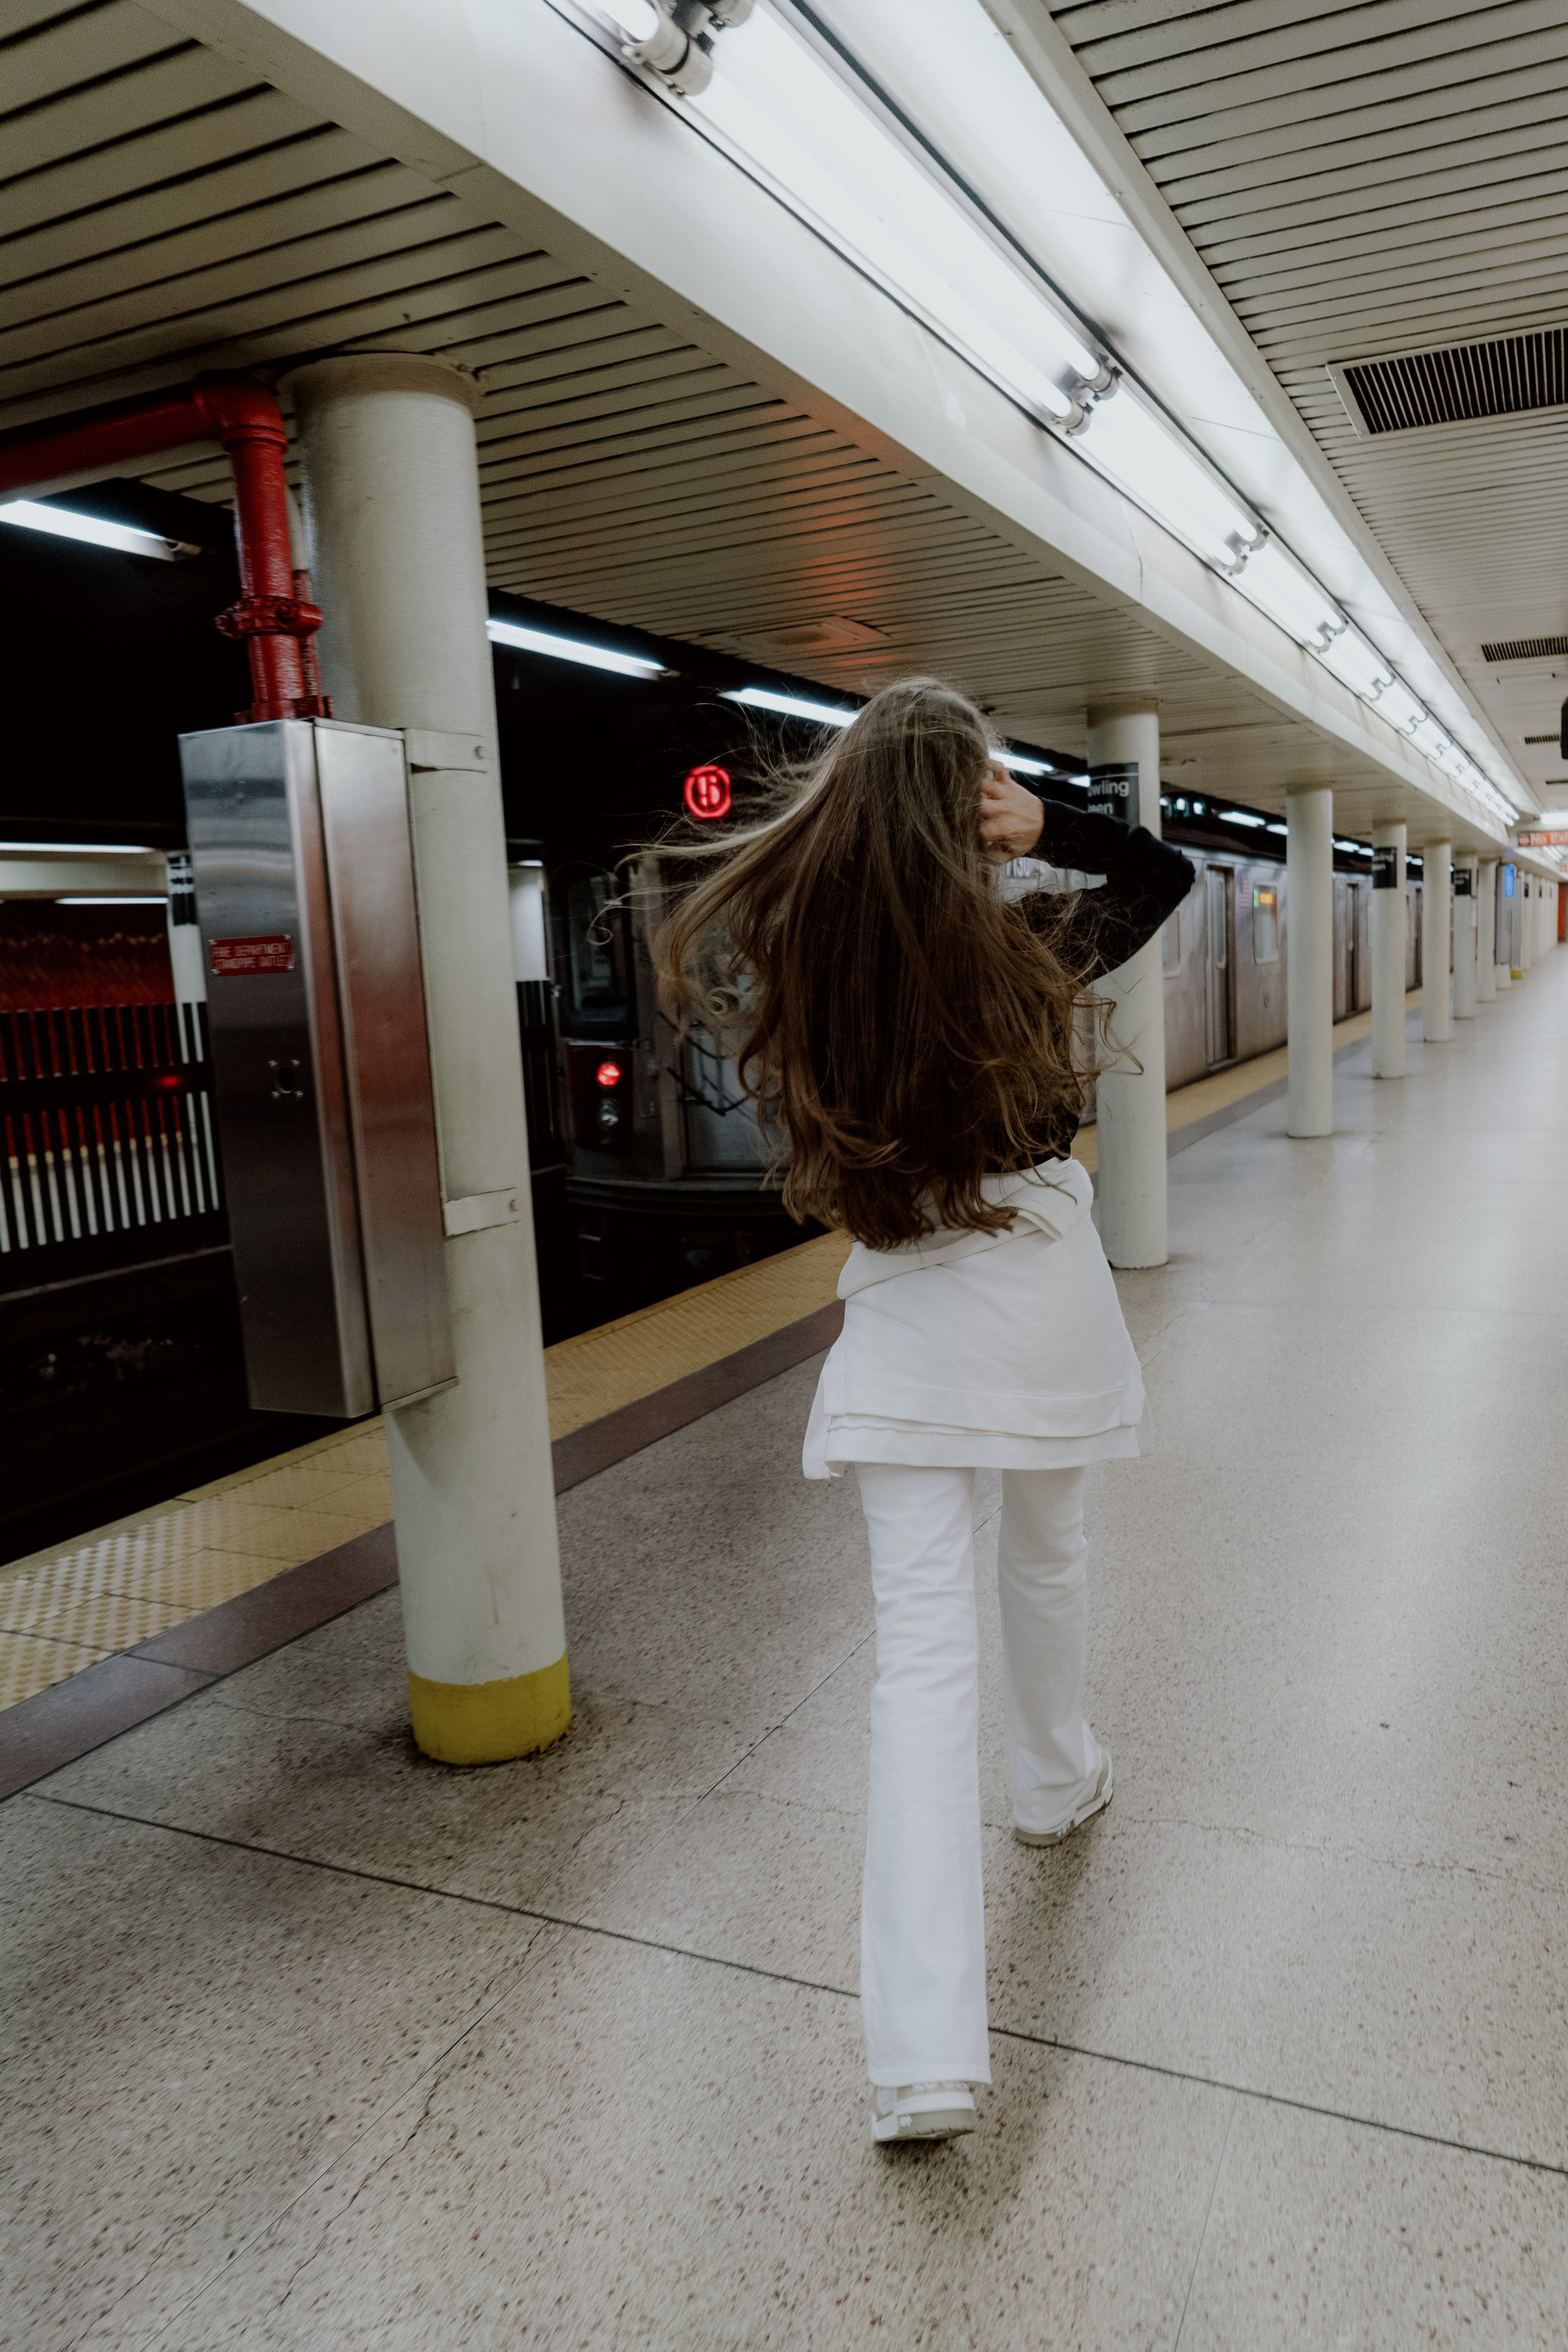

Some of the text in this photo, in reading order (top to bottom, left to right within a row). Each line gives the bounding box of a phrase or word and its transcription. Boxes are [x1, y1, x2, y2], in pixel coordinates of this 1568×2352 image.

[1088, 780, 1129, 797] owling
[1088, 803, 1114, 815] een
[1530, 832, 1547, 845] No
[233, 943, 290, 956] DEPARTMENT
